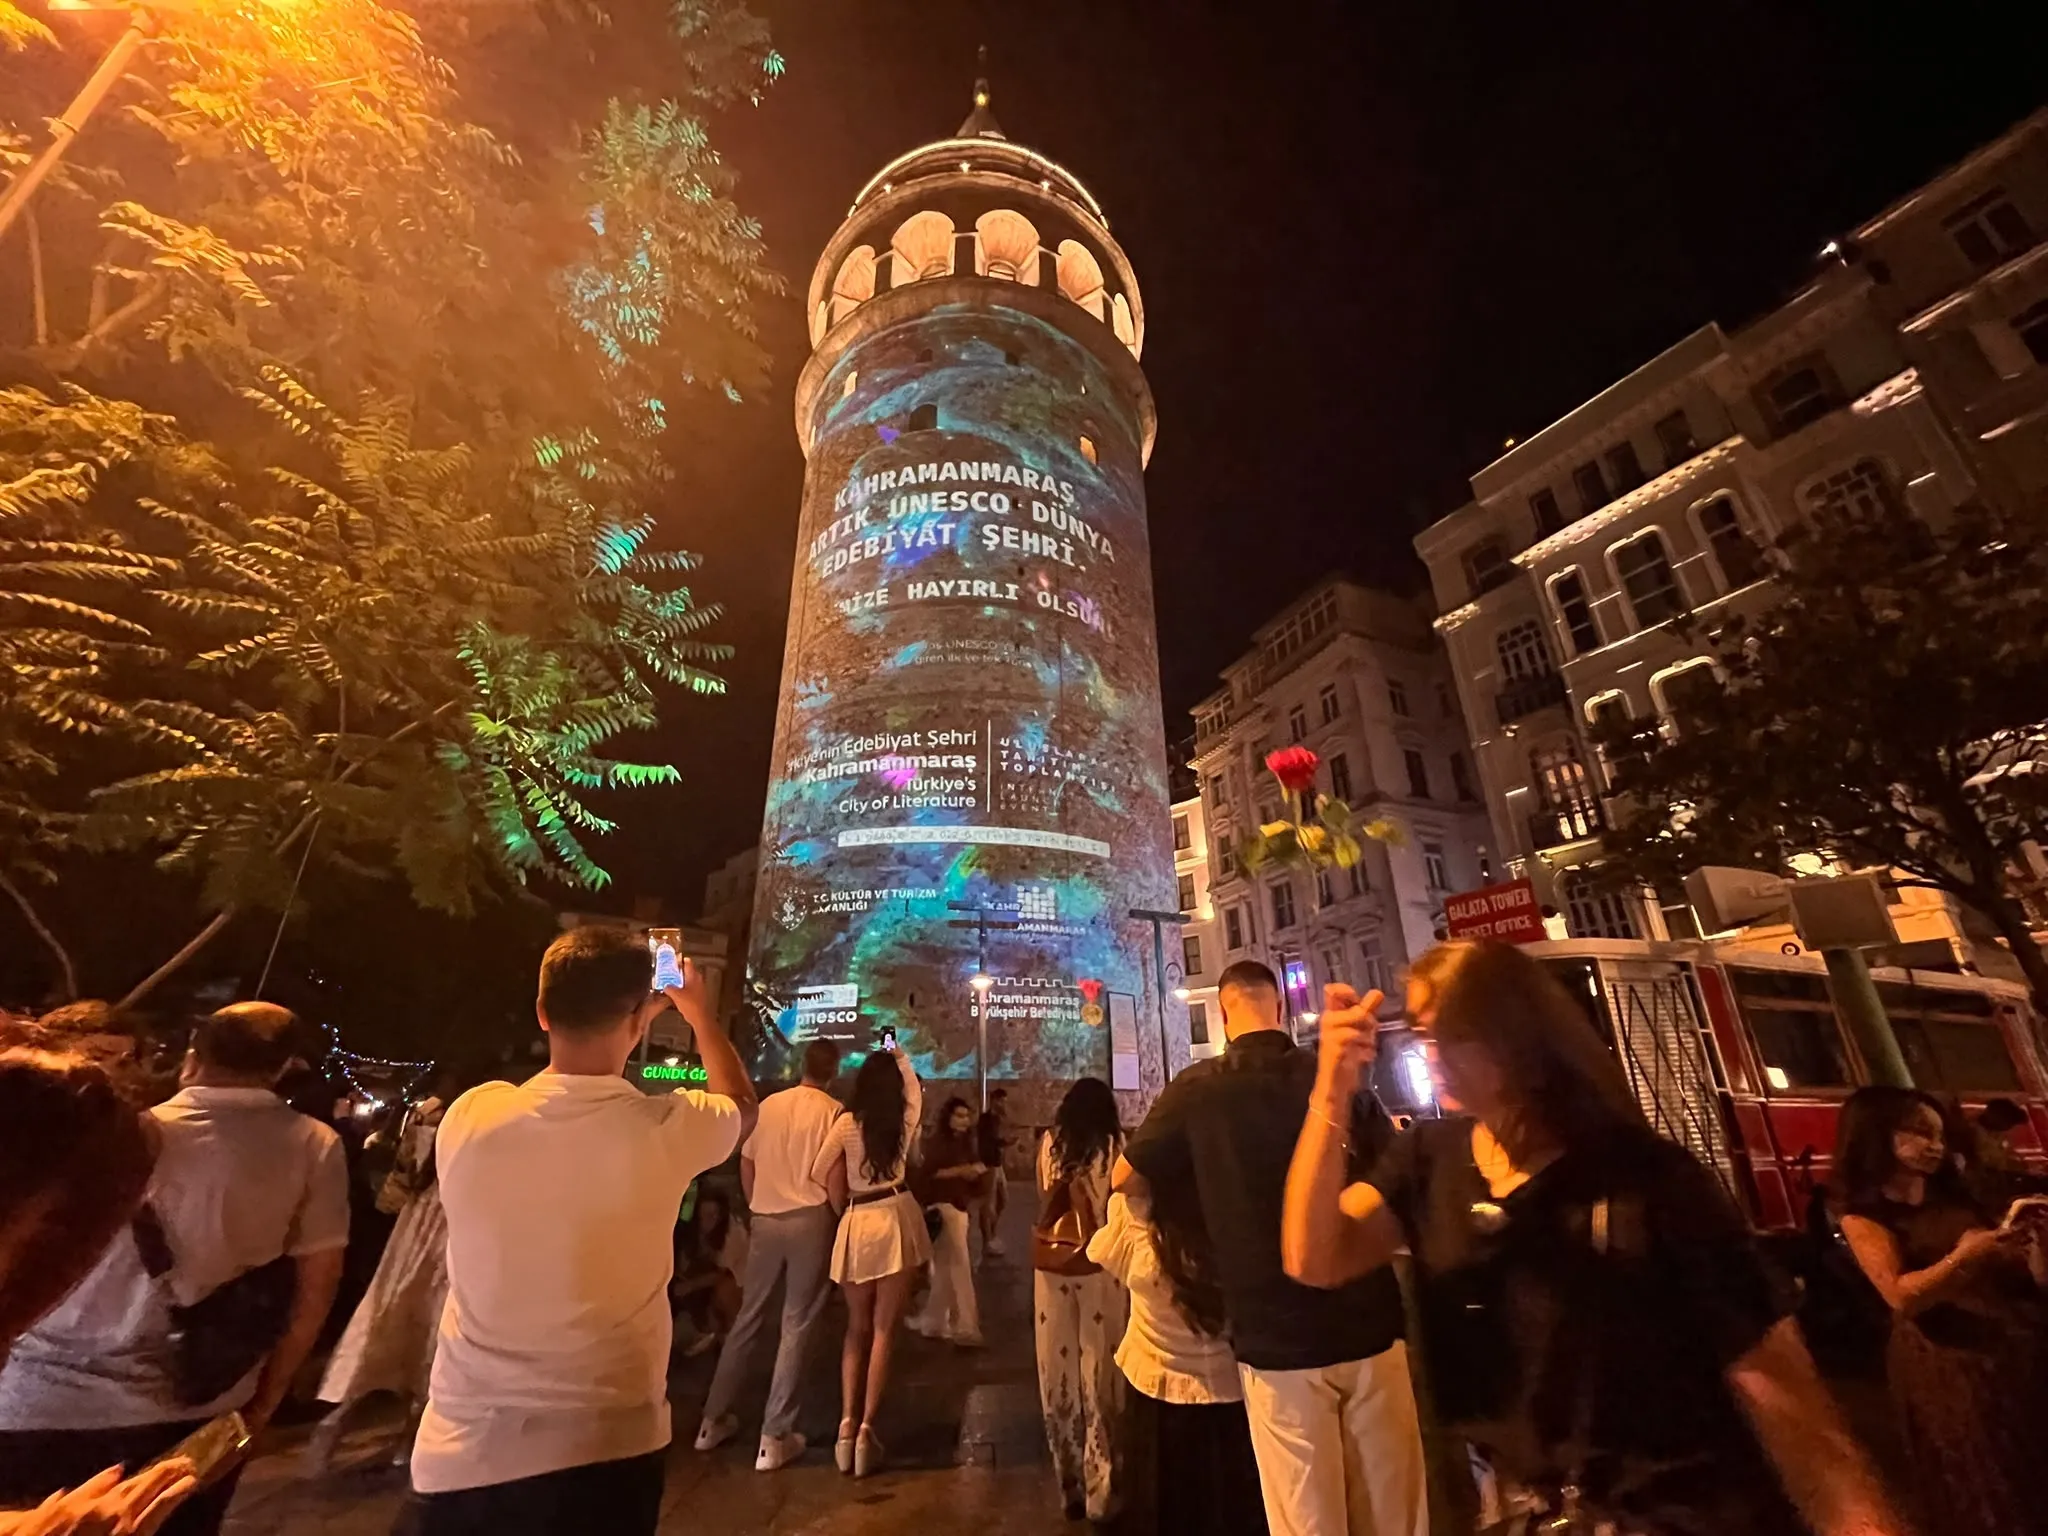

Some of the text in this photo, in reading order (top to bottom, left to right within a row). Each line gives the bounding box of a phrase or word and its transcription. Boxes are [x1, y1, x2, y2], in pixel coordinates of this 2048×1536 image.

[808, 490, 1116, 563] ARTIK UNESCO DÜNYA
[822, 520, 956, 579] EDEBİYAT
[907, 579, 1019, 602] HAYIRLI
[927, 729, 977, 748] Şehri
[805, 754, 977, 783] Kahramanmaraş
[839, 794, 977, 815] City of Literature
[874, 889, 888, 900] VE
[1448, 887, 1532, 921] GALATA TOWER
[1494, 914, 1534, 935] OFFICE
[970, 991, 1080, 1007] hramanmaraş
[970, 1005, 1028, 1020] Byükşehir
